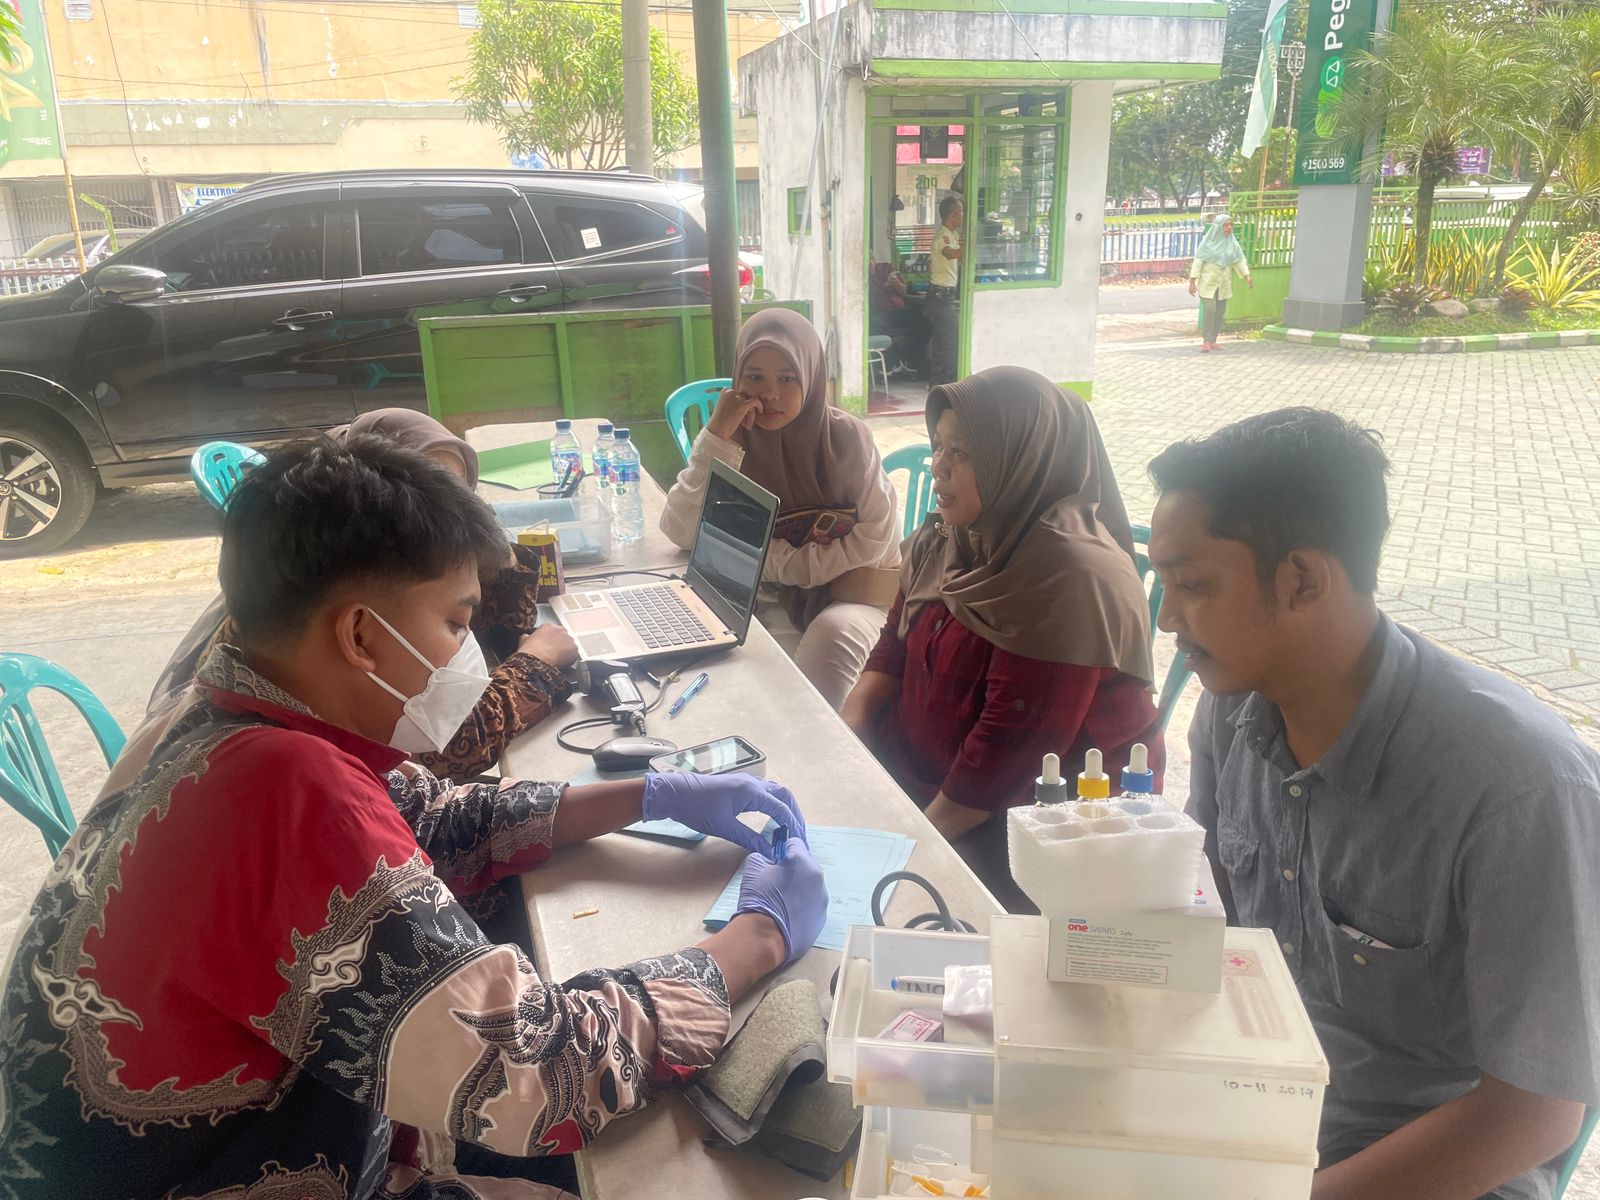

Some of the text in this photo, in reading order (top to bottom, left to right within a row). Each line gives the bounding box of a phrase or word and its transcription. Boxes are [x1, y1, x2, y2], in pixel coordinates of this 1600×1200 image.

[1328, 157, 1345, 169] 569
[1067, 923, 1089, 933] one
[1089, 925, 1117, 936] SWABS
